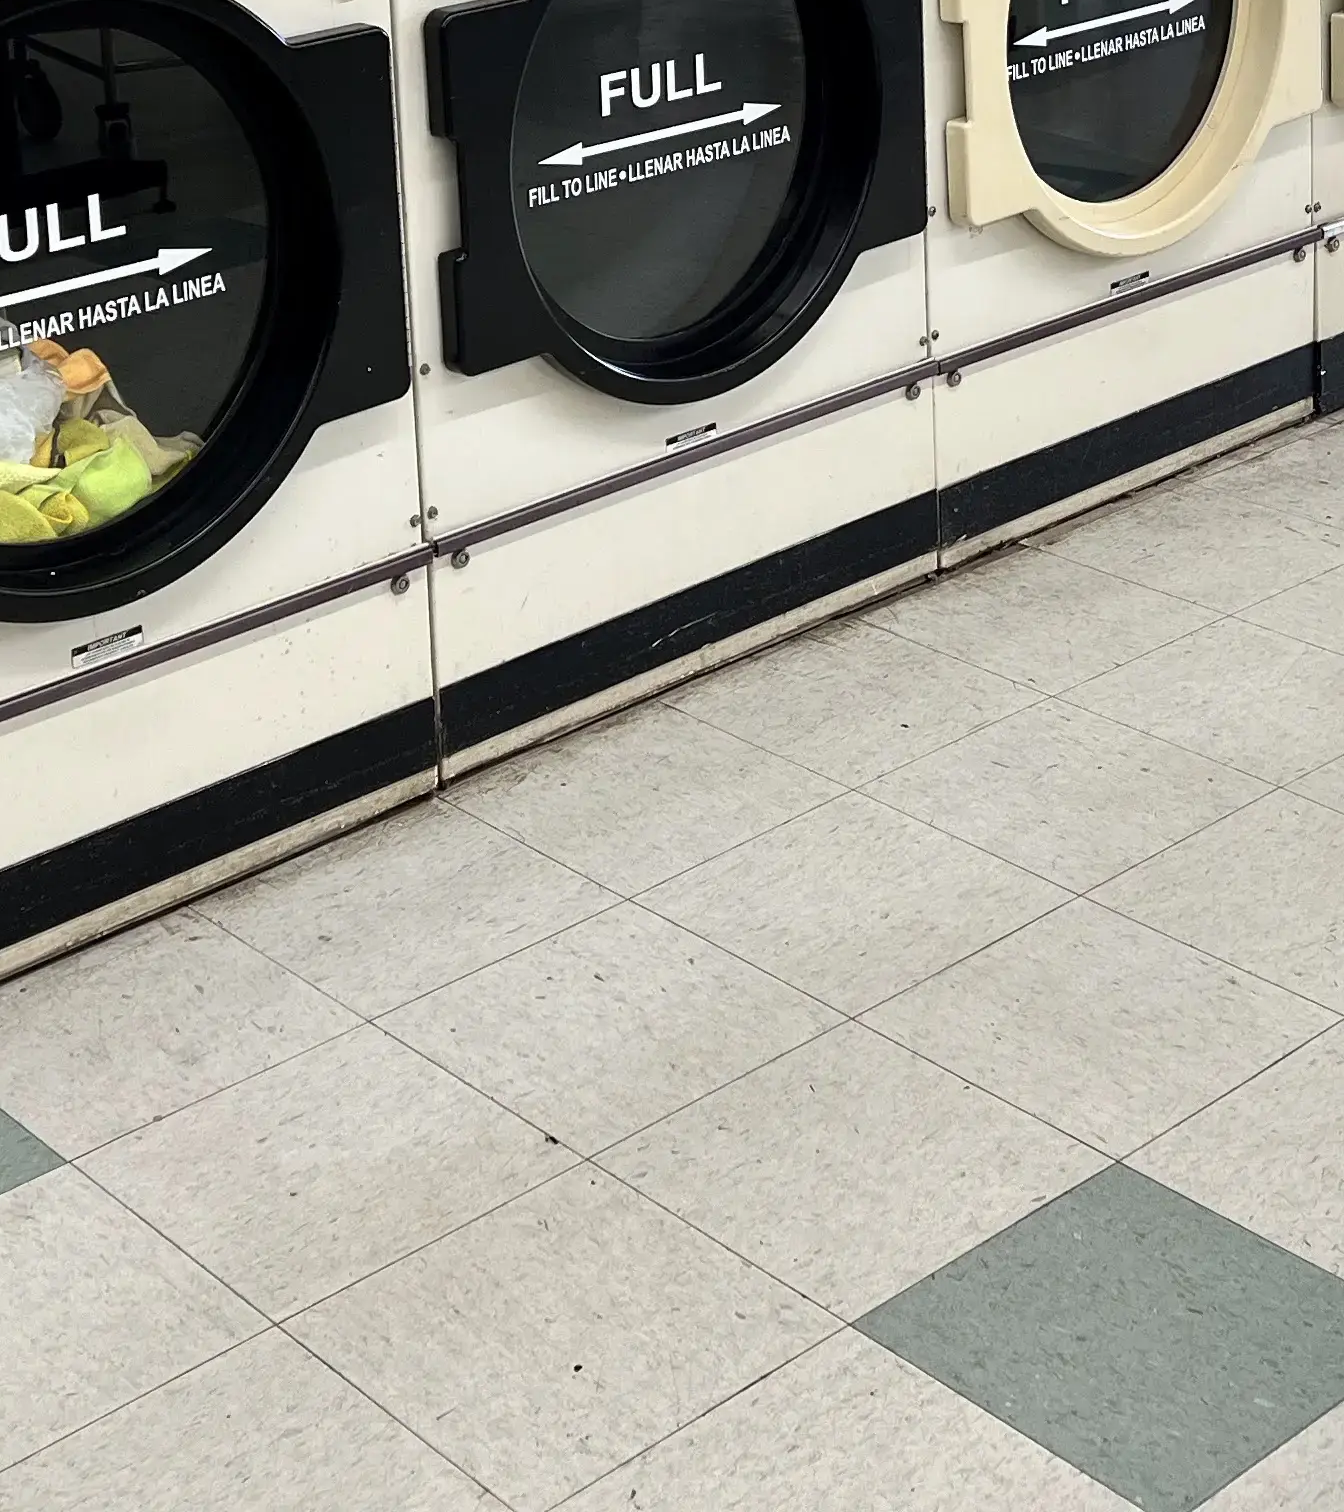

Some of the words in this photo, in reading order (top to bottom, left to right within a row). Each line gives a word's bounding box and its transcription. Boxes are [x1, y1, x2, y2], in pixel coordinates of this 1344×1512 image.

[1031, 58, 1046, 75] TO
[1049, 50, 1073, 70] LINE
[1081, 37, 1124, 62] LLENAR
[1125, 28, 1159, 51] HASTA
[1161, 24, 1174, 39] LA
[1176, 15, 1205, 36] LINEA
[600, 53, 722, 117] FULL
[528, 184, 559, 208] FILL
[561, 178, 582, 199] TO
[585, 168, 618, 193] LINE
[628, 152, 683, 182] LLENAR
[686, 144, 730, 168] HASTA
[732, 138, 750, 156] LA
[752, 125, 791, 152] LINEA
[78, 296, 141, 330] HASTA
[144, 289, 170, 310] LA
[171, 273, 226, 304] LINEA
